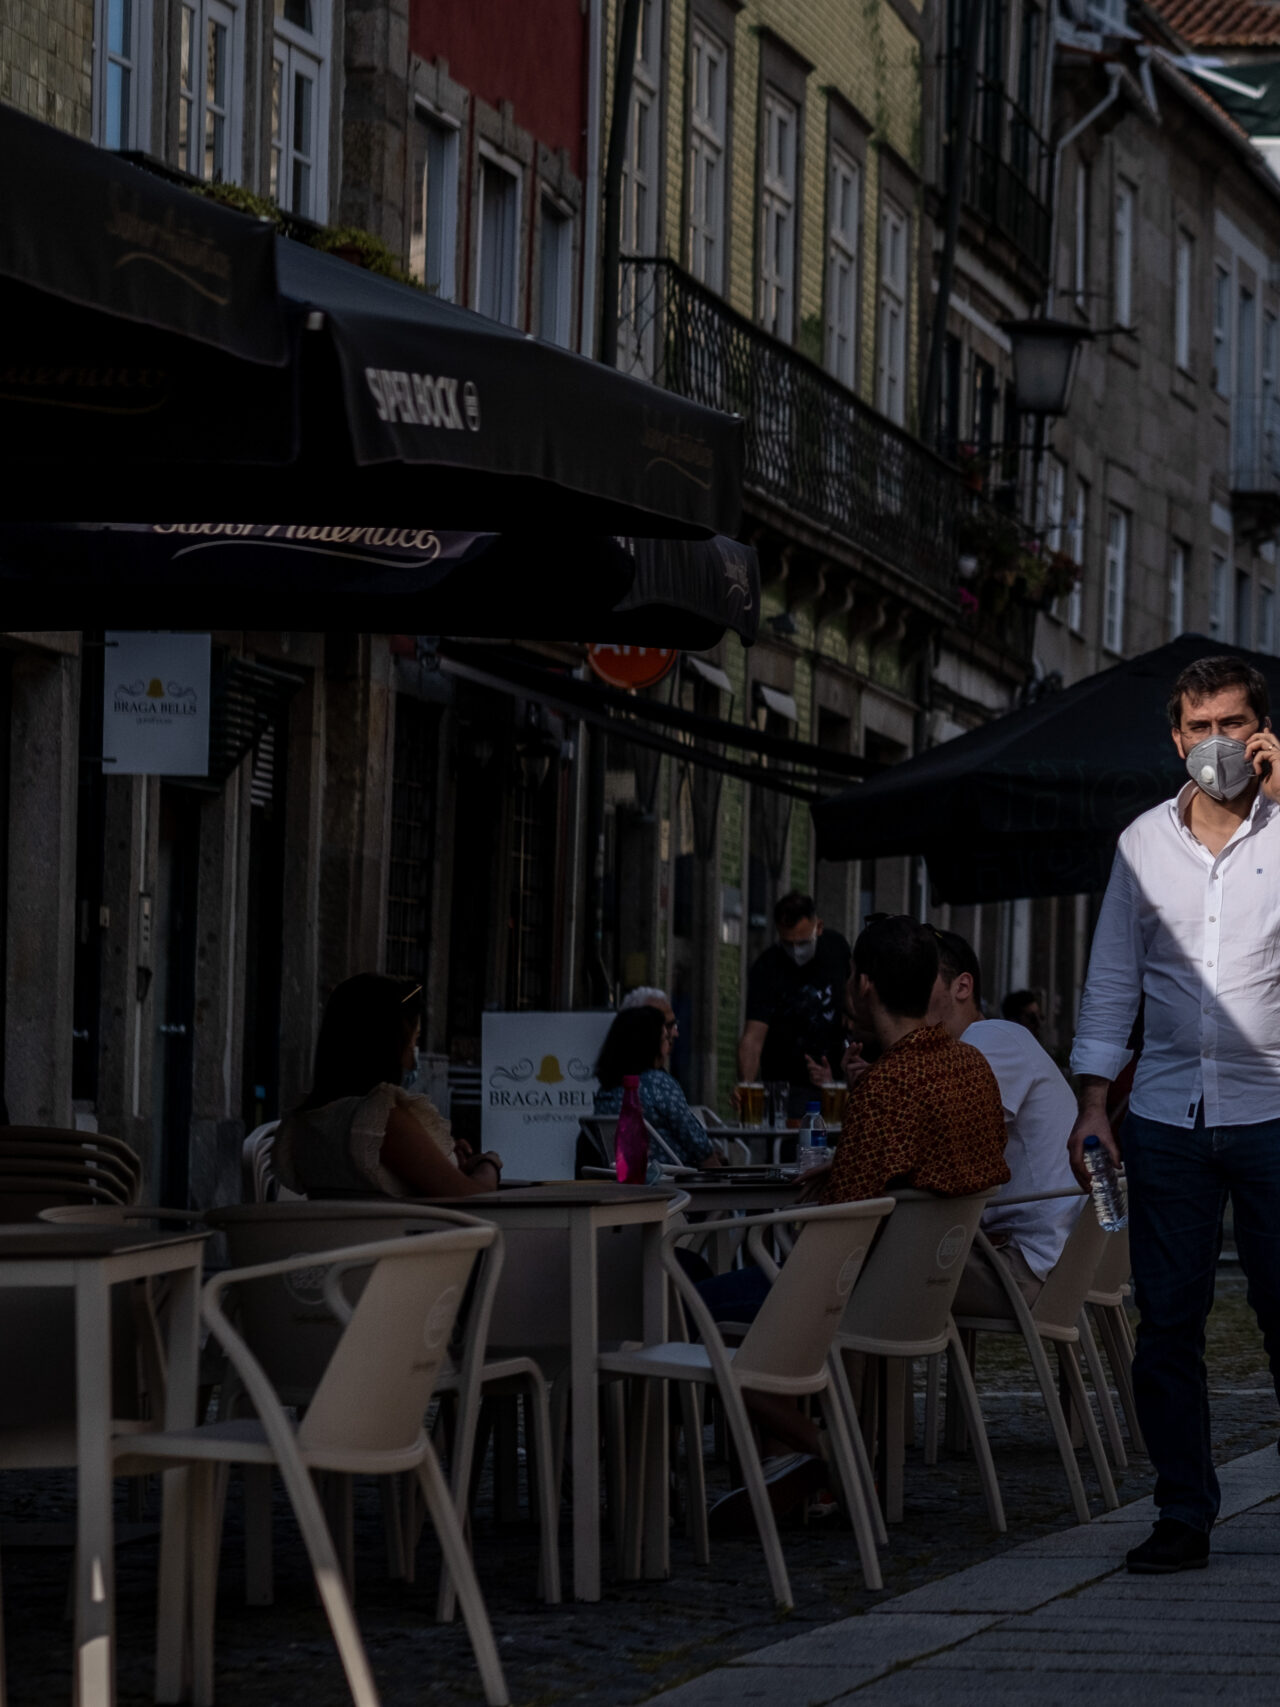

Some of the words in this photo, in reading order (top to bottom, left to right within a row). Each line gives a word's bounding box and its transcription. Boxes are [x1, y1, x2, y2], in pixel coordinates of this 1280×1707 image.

[114, 701, 156, 713] BRAGA
[160, 703, 197, 715] BELLS
[489, 1090, 553, 1106] BRAGA
[558, 1090, 597, 1106] BEL
